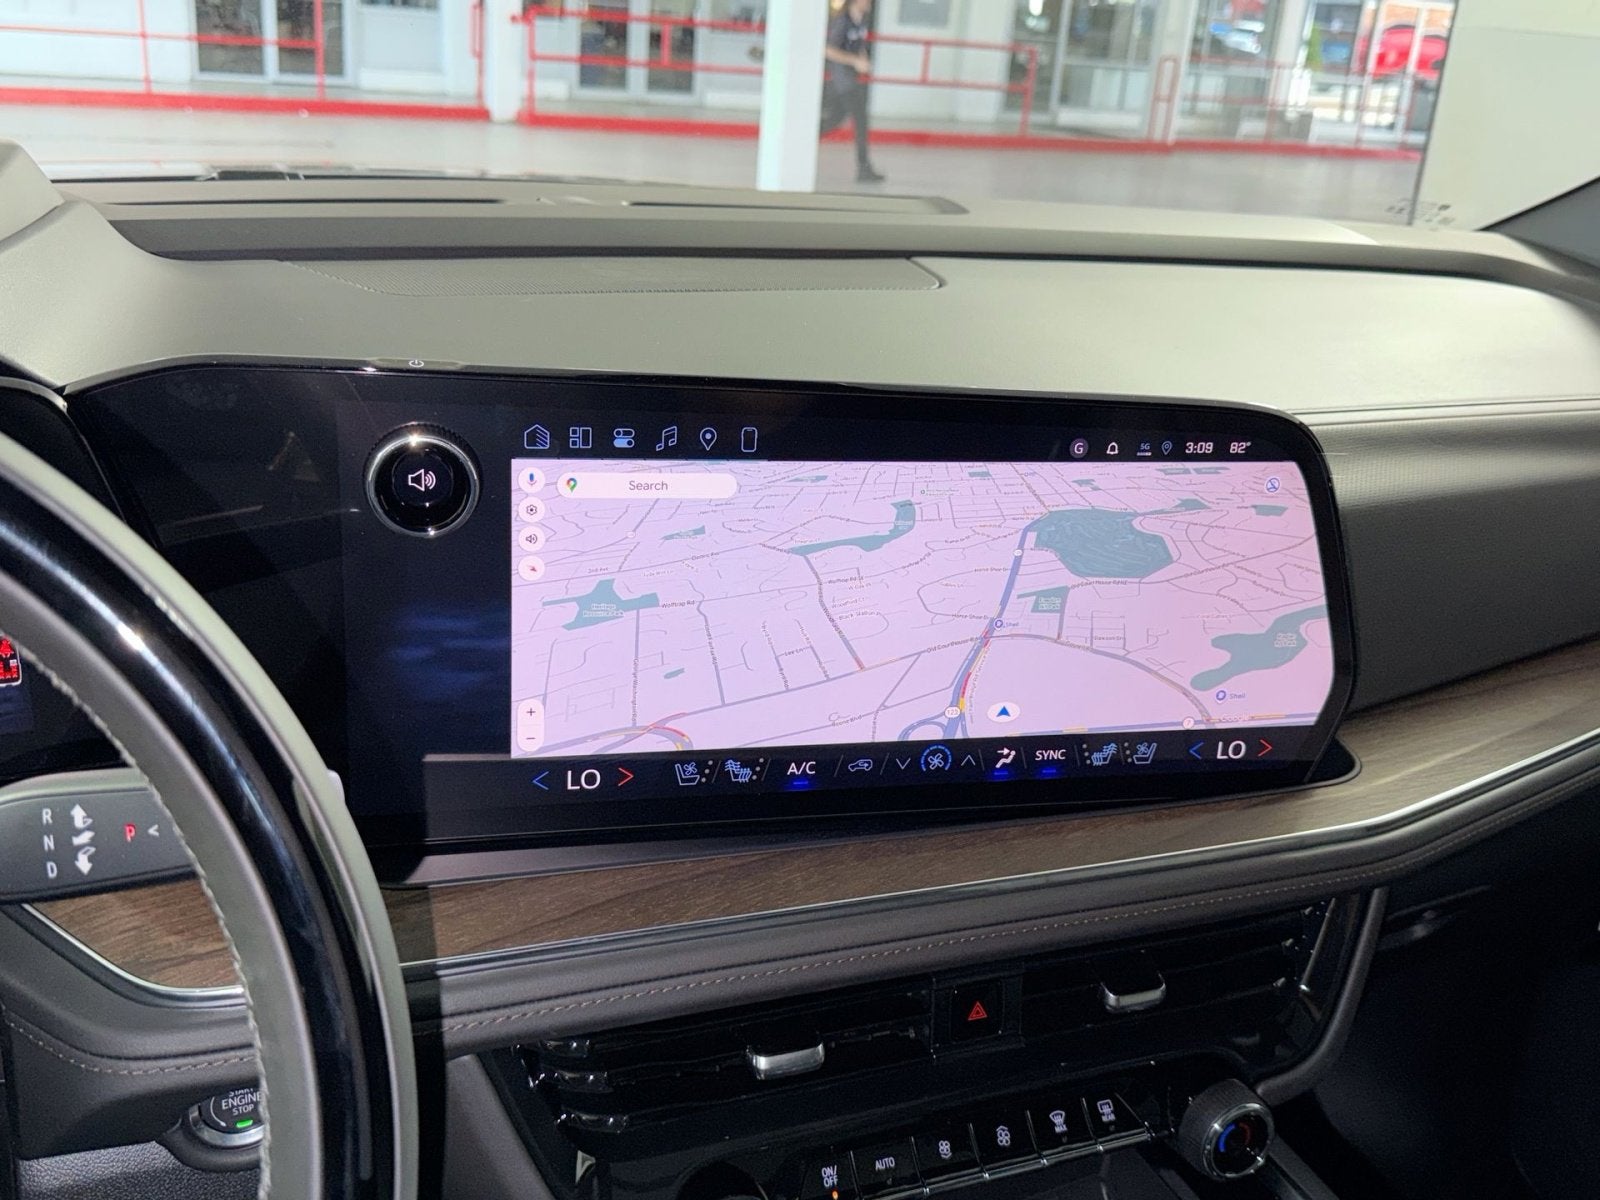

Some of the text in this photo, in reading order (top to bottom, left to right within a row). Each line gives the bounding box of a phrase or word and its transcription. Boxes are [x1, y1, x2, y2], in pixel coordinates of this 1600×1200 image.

[1074, 442, 1084, 454] G
[1185, 442, 1214, 454] 3:09
[1229, 441, 1252, 454] 82°
[628, 480, 669, 491] Search
[1035, 749, 1067, 761] SYNC
[1216, 740, 1247, 759] LO
[787, 761, 816, 776] A/C
[567, 769, 601, 790] LO
[42, 808, 52, 824] R
[124, 824, 136, 842] P
[44, 835, 55, 850] N
[46, 862, 58, 878] D
[221, 1091, 262, 1110] ENGINE
[232, 1103, 254, 1116] STOP
[875, 1156, 896, 1171] AUTO
[821, 1165, 837, 1178] ON/
[823, 1175, 839, 1188] OFF
